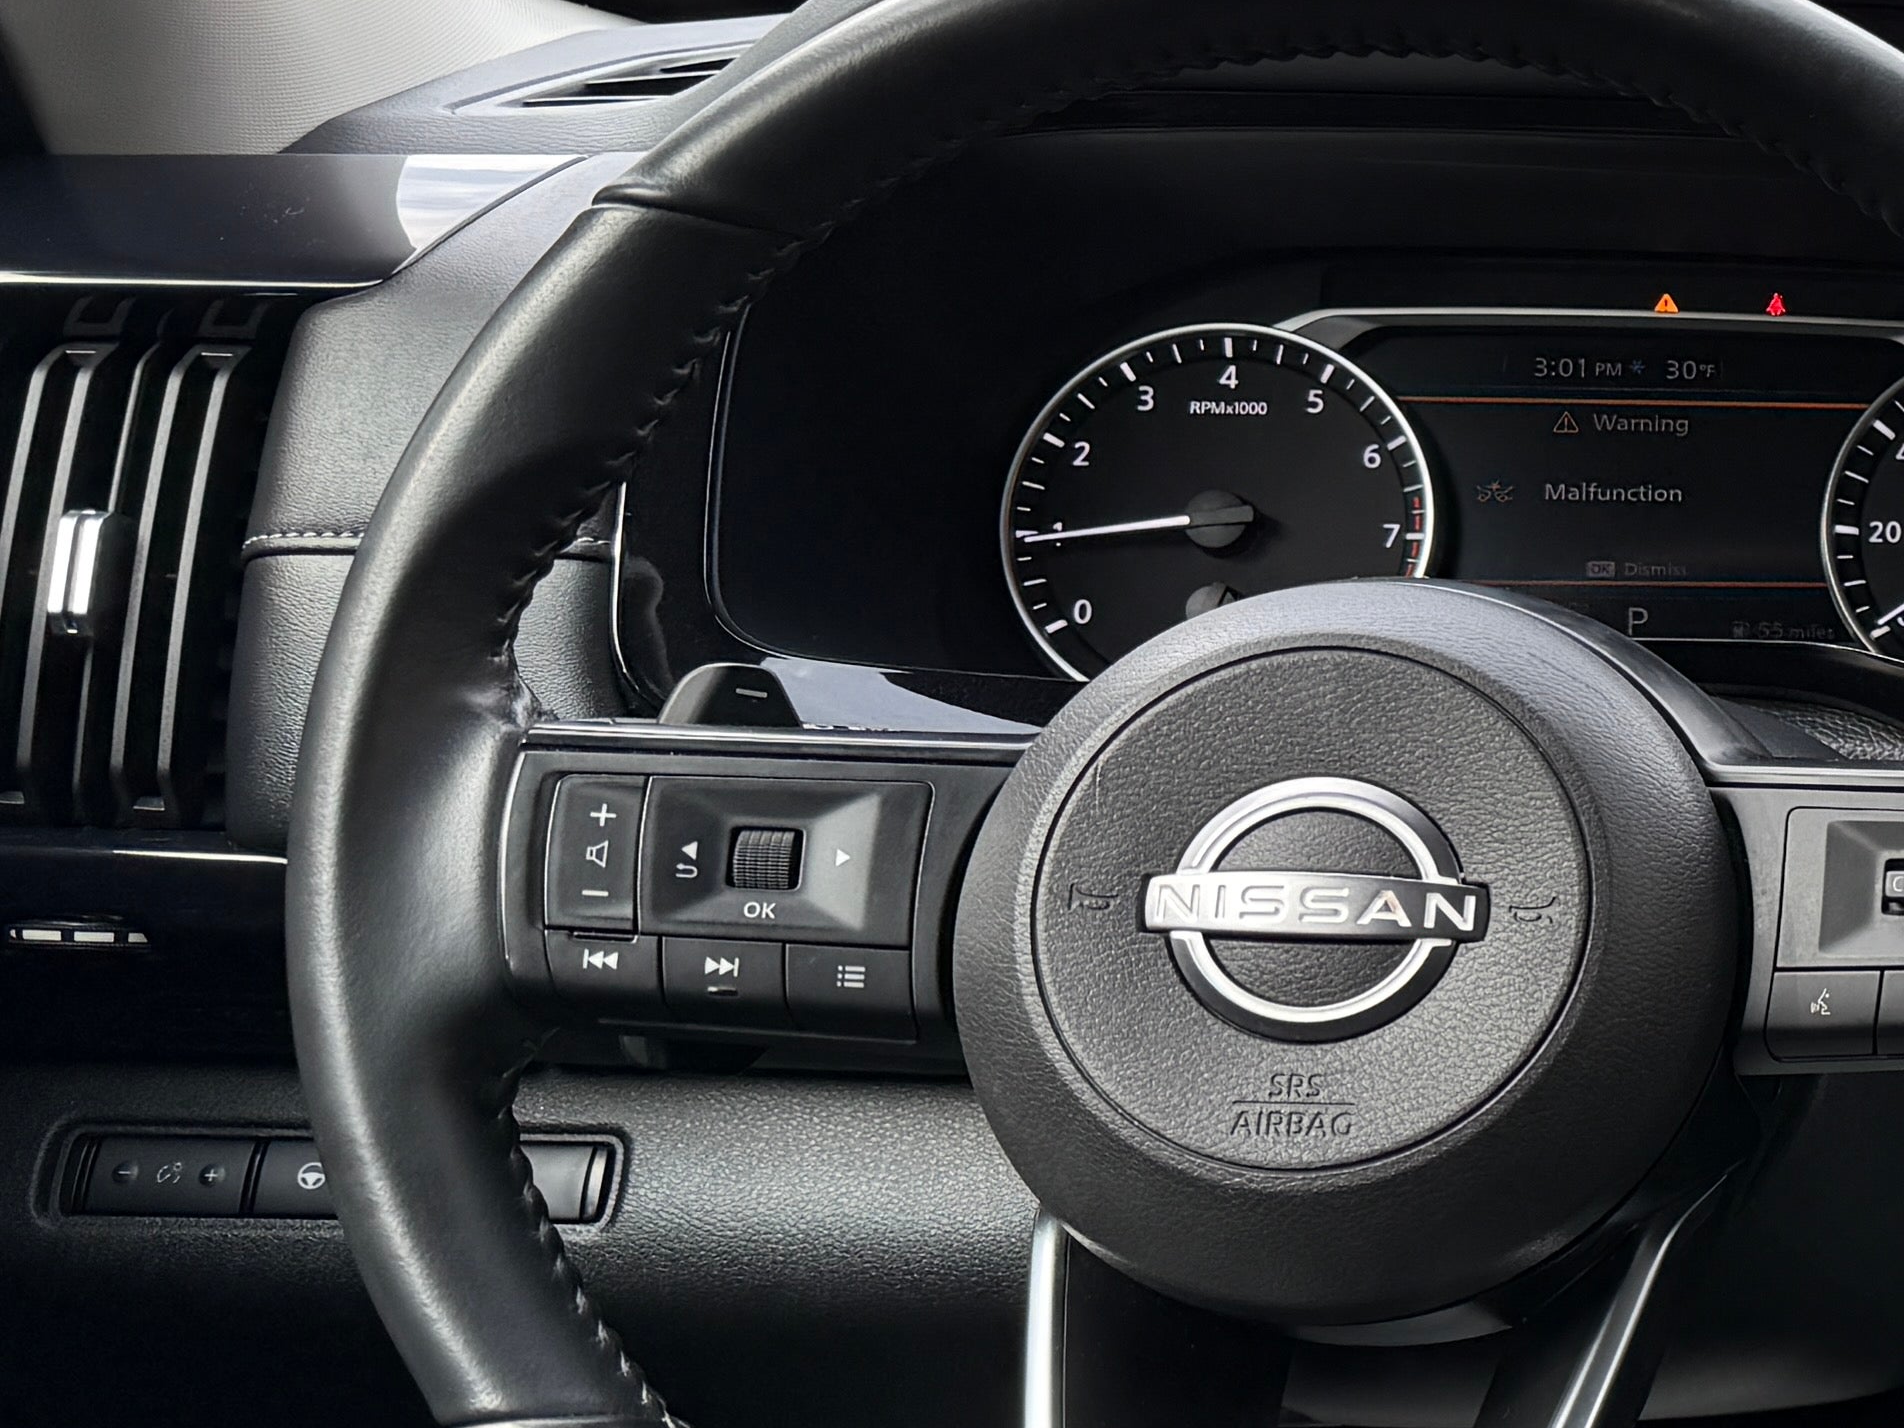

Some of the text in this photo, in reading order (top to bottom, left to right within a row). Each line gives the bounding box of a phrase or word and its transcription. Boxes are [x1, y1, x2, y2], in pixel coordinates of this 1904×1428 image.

[1218, 365, 1239, 389] 4
[1534, 357, 1622, 377] 3:01 PM
[1137, 386, 1155, 412] 3
[1189, 400, 1268, 416] RPMx1000
[1306, 389, 1324, 414] 5
[1593, 413, 1690, 437] Warning
[1073, 442, 1091, 466] 2
[1362, 445, 1382, 469] 6
[1544, 483, 1683, 503] Malfunction
[1383, 523, 1400, 549] 7
[1868, 521, 1902, 544] 20
[1073, 599, 1093, 625] 0
[1627, 607, 1649, 635] P
[743, 902, 776, 920] OK
[1154, 882, 1478, 932] NISSAN
[1267, 1072, 1325, 1099] SRS
[1230, 1109, 1355, 1137] AIRBAG
